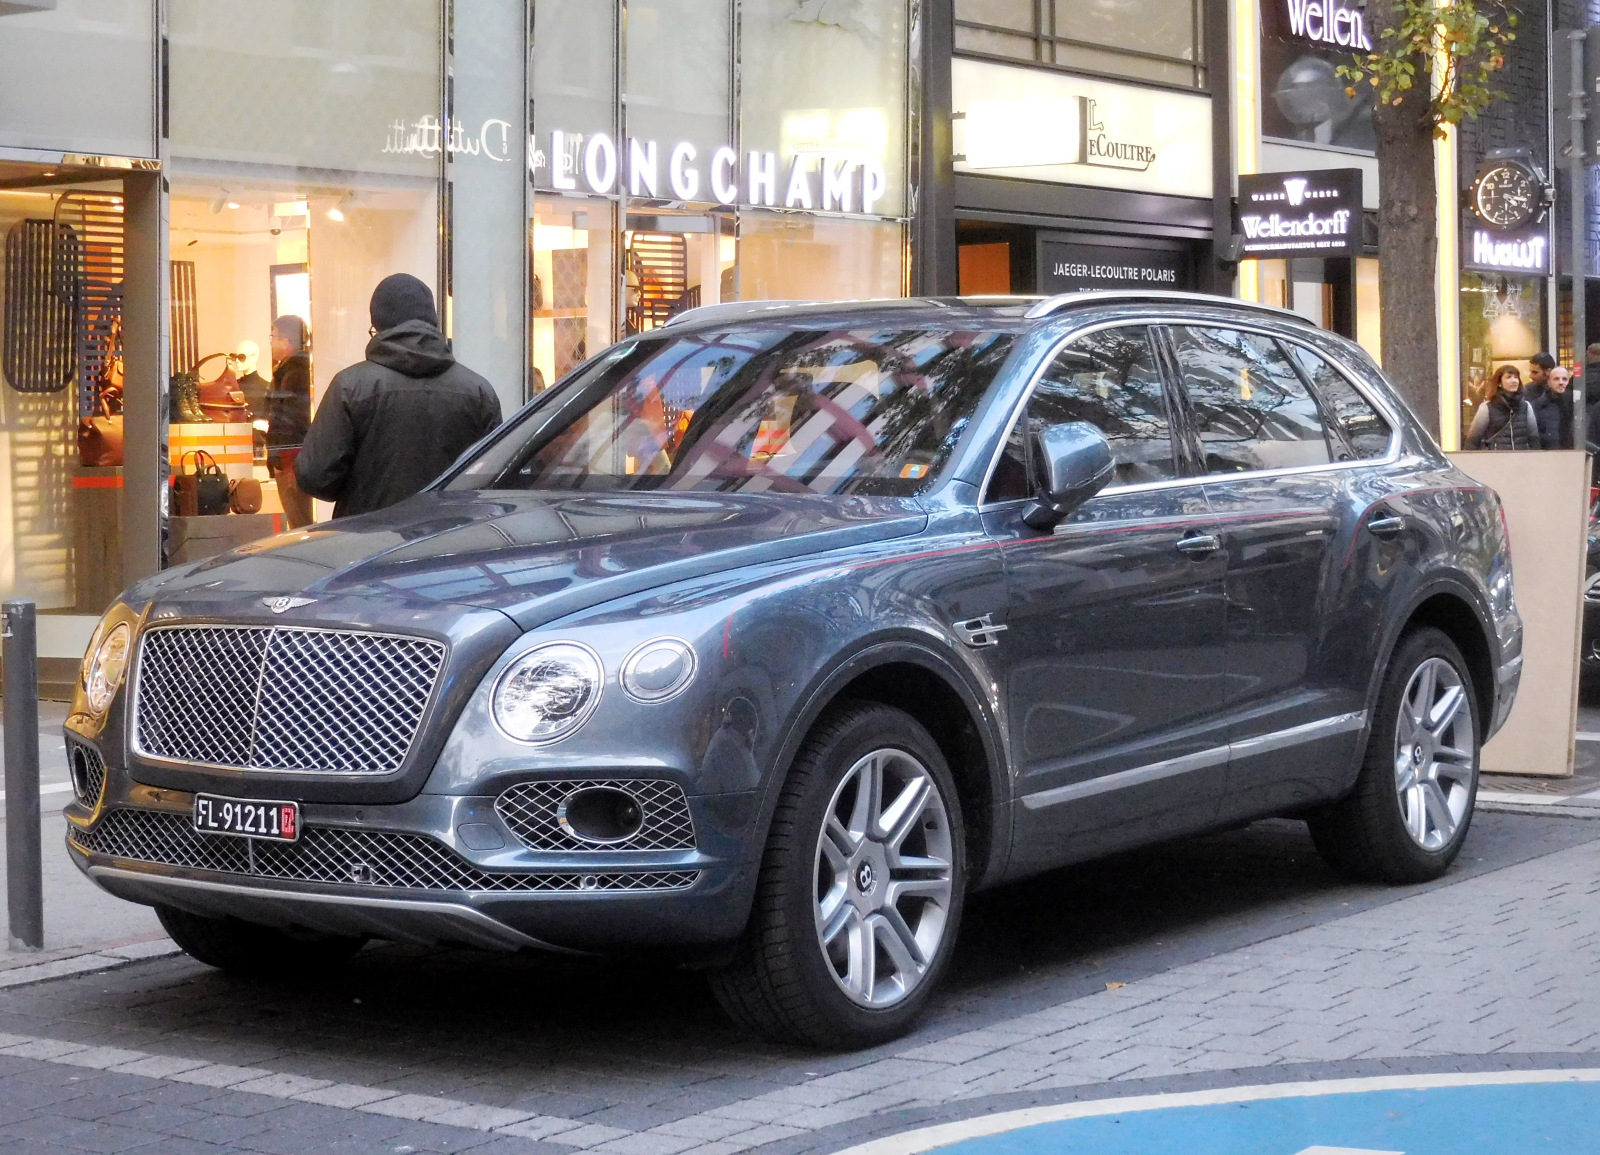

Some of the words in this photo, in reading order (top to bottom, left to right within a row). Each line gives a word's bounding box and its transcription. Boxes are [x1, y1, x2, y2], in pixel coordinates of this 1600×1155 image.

[1287, 0, 1372, 51] Wellen
[551, 129, 885, 214] LONGCHAMP
[1241, 210, 1350, 239] Wellendorff
[1053, 262, 1138, 280] JAEGER-LECOULTRE
[1141, 268, 1176, 282] POLARIS
